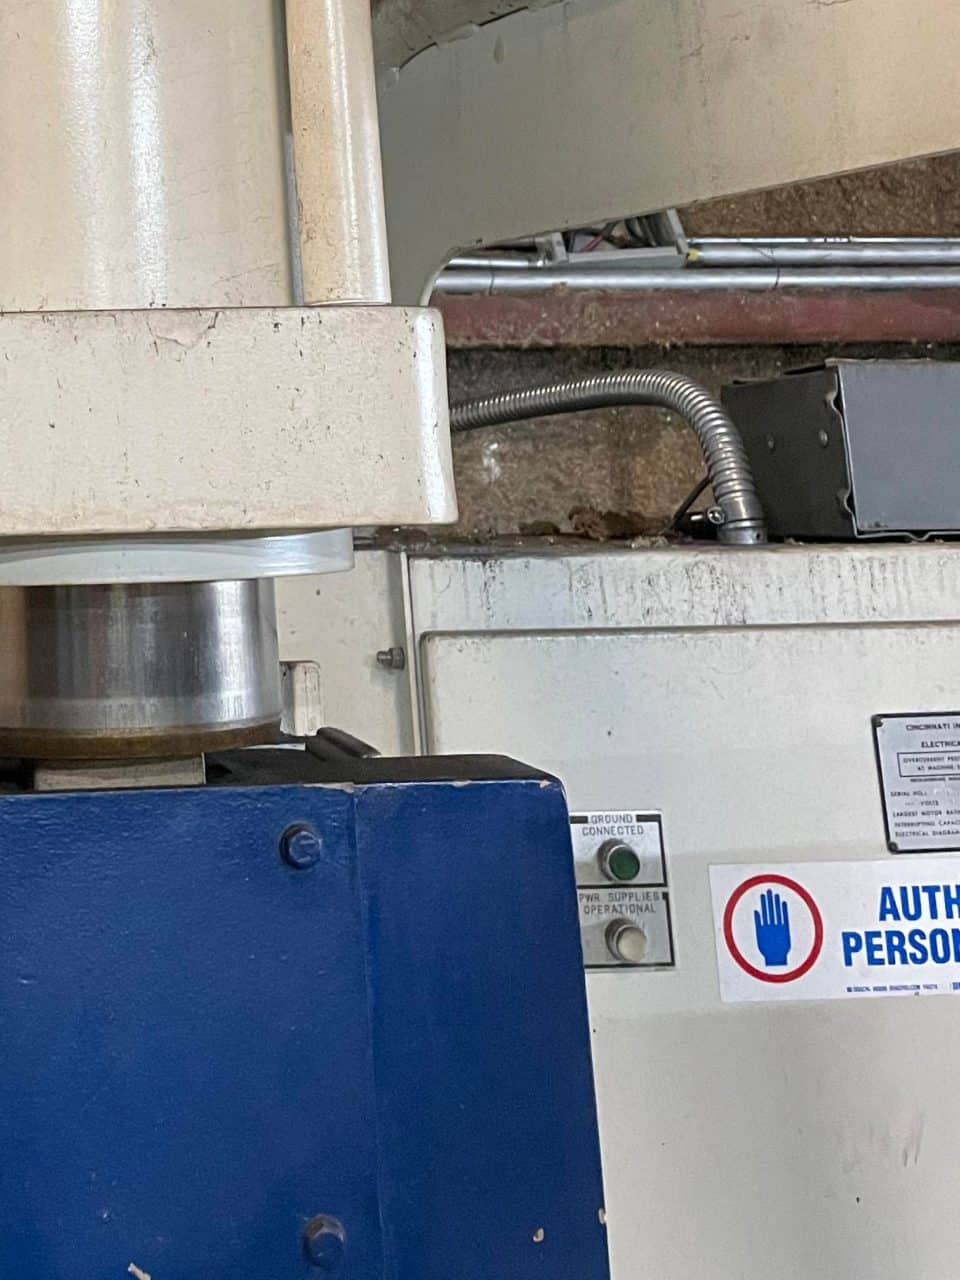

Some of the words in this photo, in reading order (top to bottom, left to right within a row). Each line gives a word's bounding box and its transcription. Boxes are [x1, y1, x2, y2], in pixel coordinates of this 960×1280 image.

[591, 814, 634, 824] GROUND
[582, 825, 644, 836] CONNECTED
[607, 891, 660, 902] SUPPLIES
[583, 903, 656, 914] OPERATIONAL
[879, 884, 960, 922] AUTH
